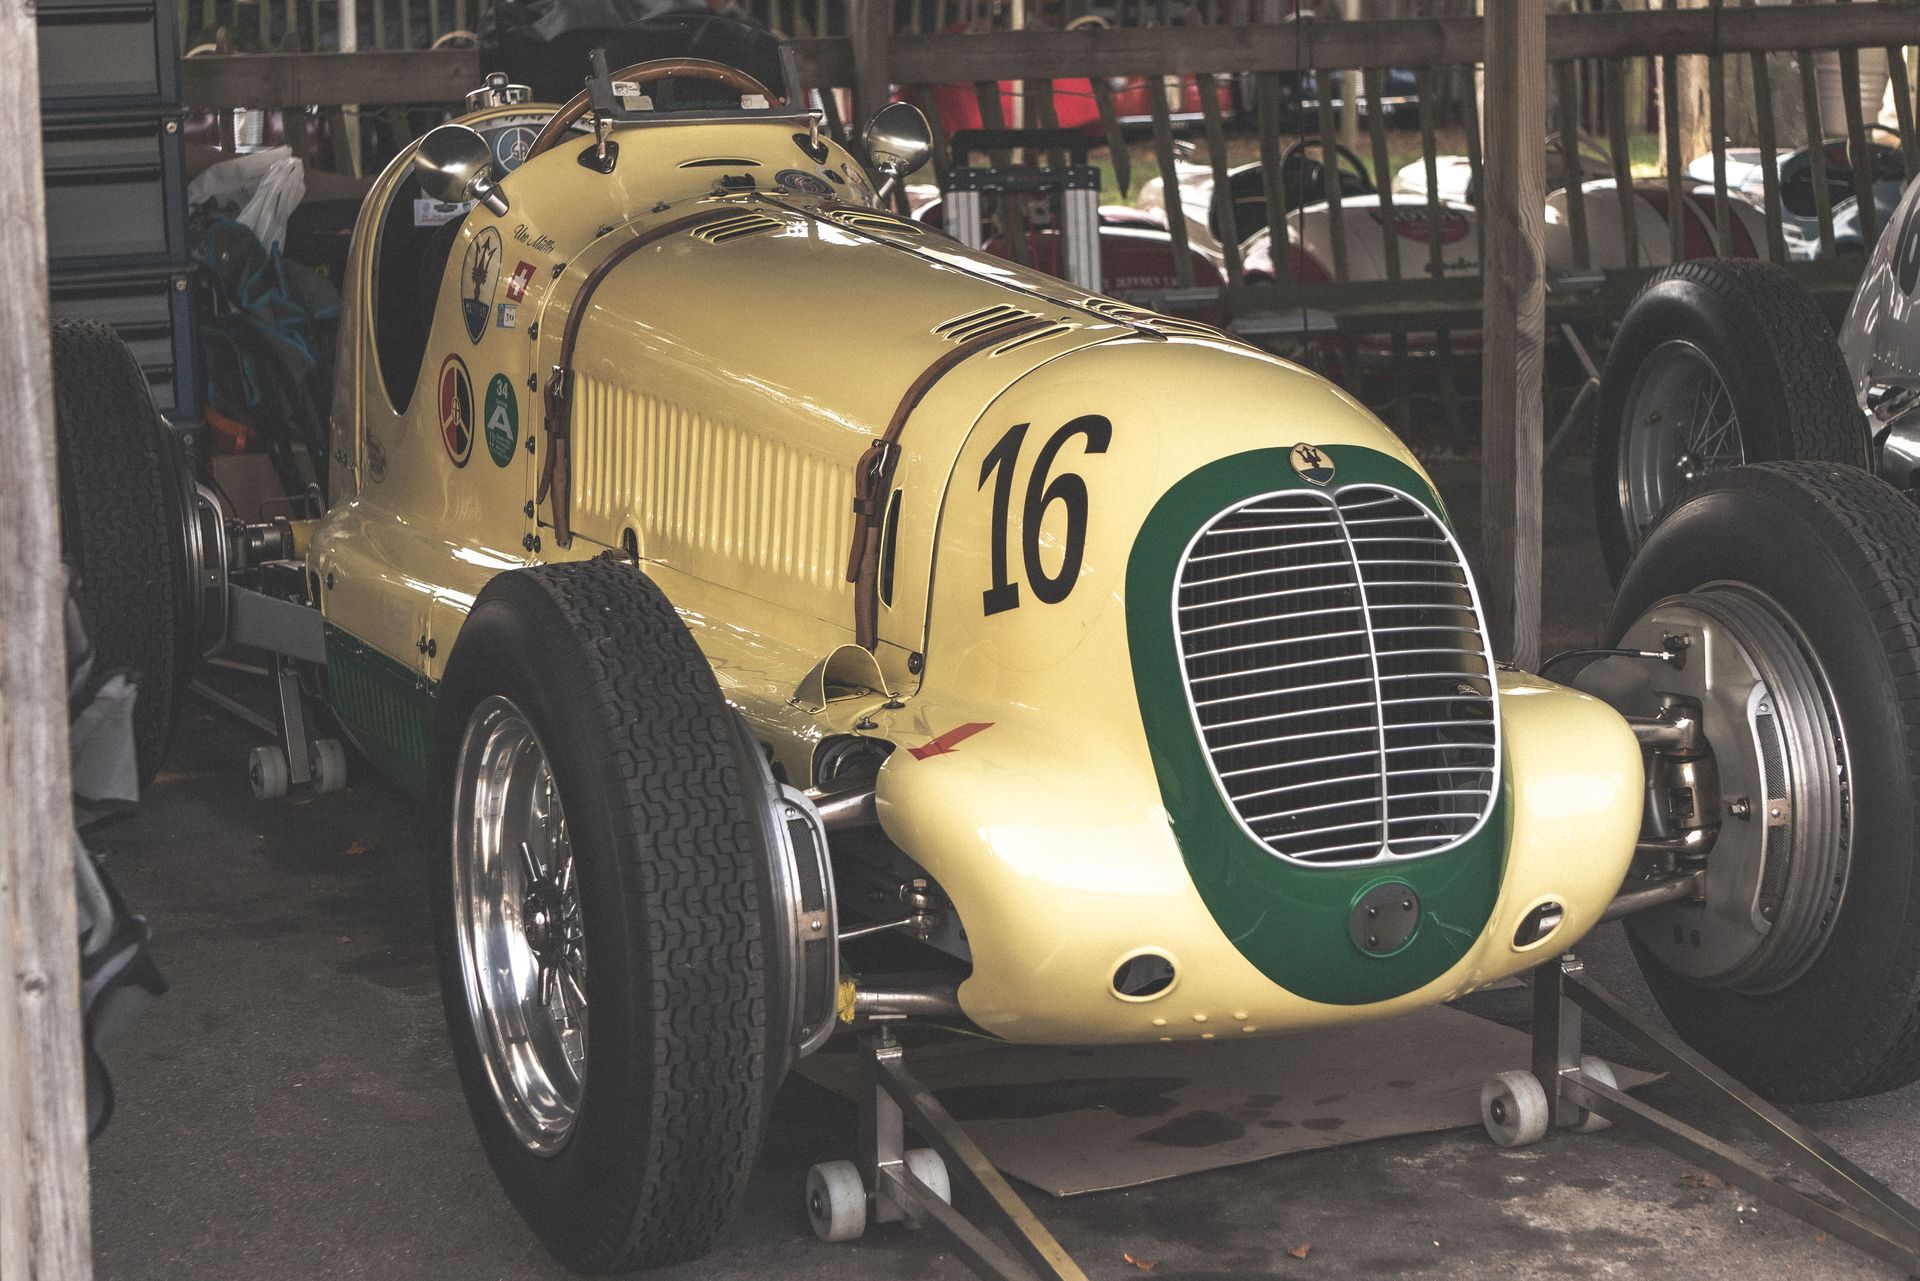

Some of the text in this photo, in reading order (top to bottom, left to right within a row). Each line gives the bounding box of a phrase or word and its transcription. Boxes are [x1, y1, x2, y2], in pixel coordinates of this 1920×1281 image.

[496, 379, 508, 399] 34
[487, 405, 514, 441] A
[978, 414, 1113, 617] 16
